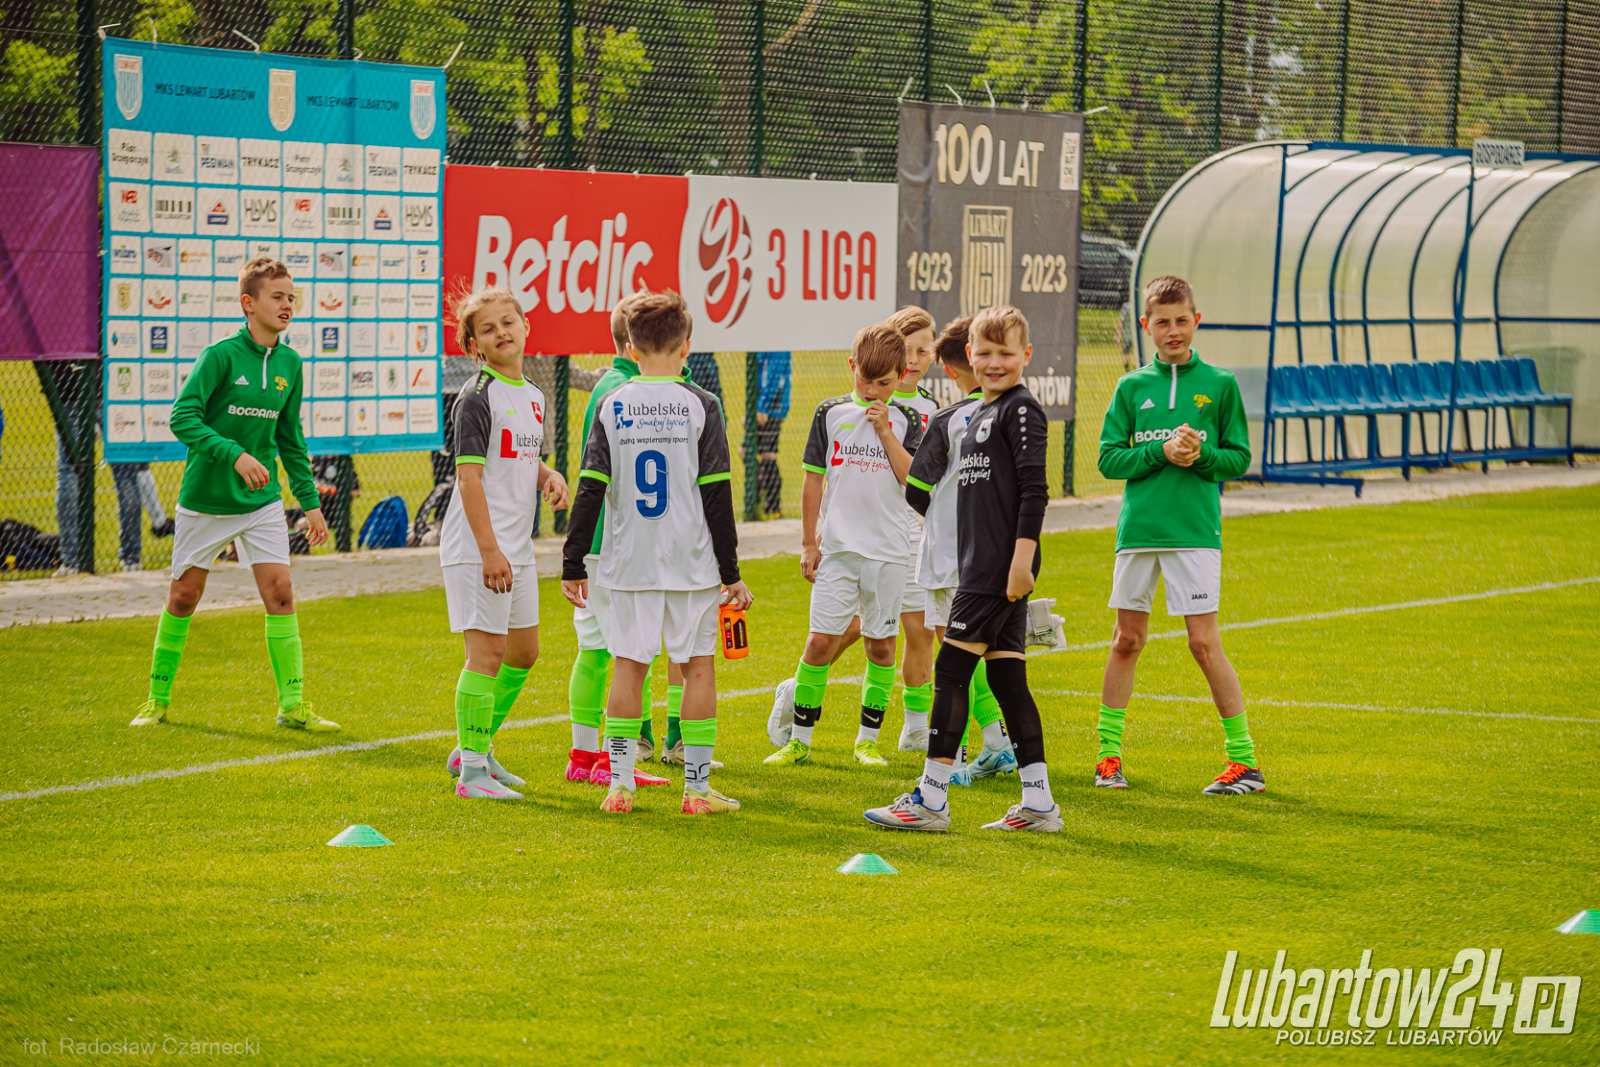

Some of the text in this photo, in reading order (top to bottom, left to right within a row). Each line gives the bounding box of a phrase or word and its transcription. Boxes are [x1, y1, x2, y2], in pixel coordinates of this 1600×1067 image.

[935, 122, 993, 185] 100
[997, 139, 1045, 187] LAT
[472, 212, 654, 314] Betclic
[767, 228, 877, 302] 3 LIGA
[907, 251, 953, 292] 1923
[1020, 254, 1068, 293] 2023
[227, 404, 280, 419] BOGDANK
[628, 403, 689, 416] lubelskie
[635, 450, 669, 520] 9
